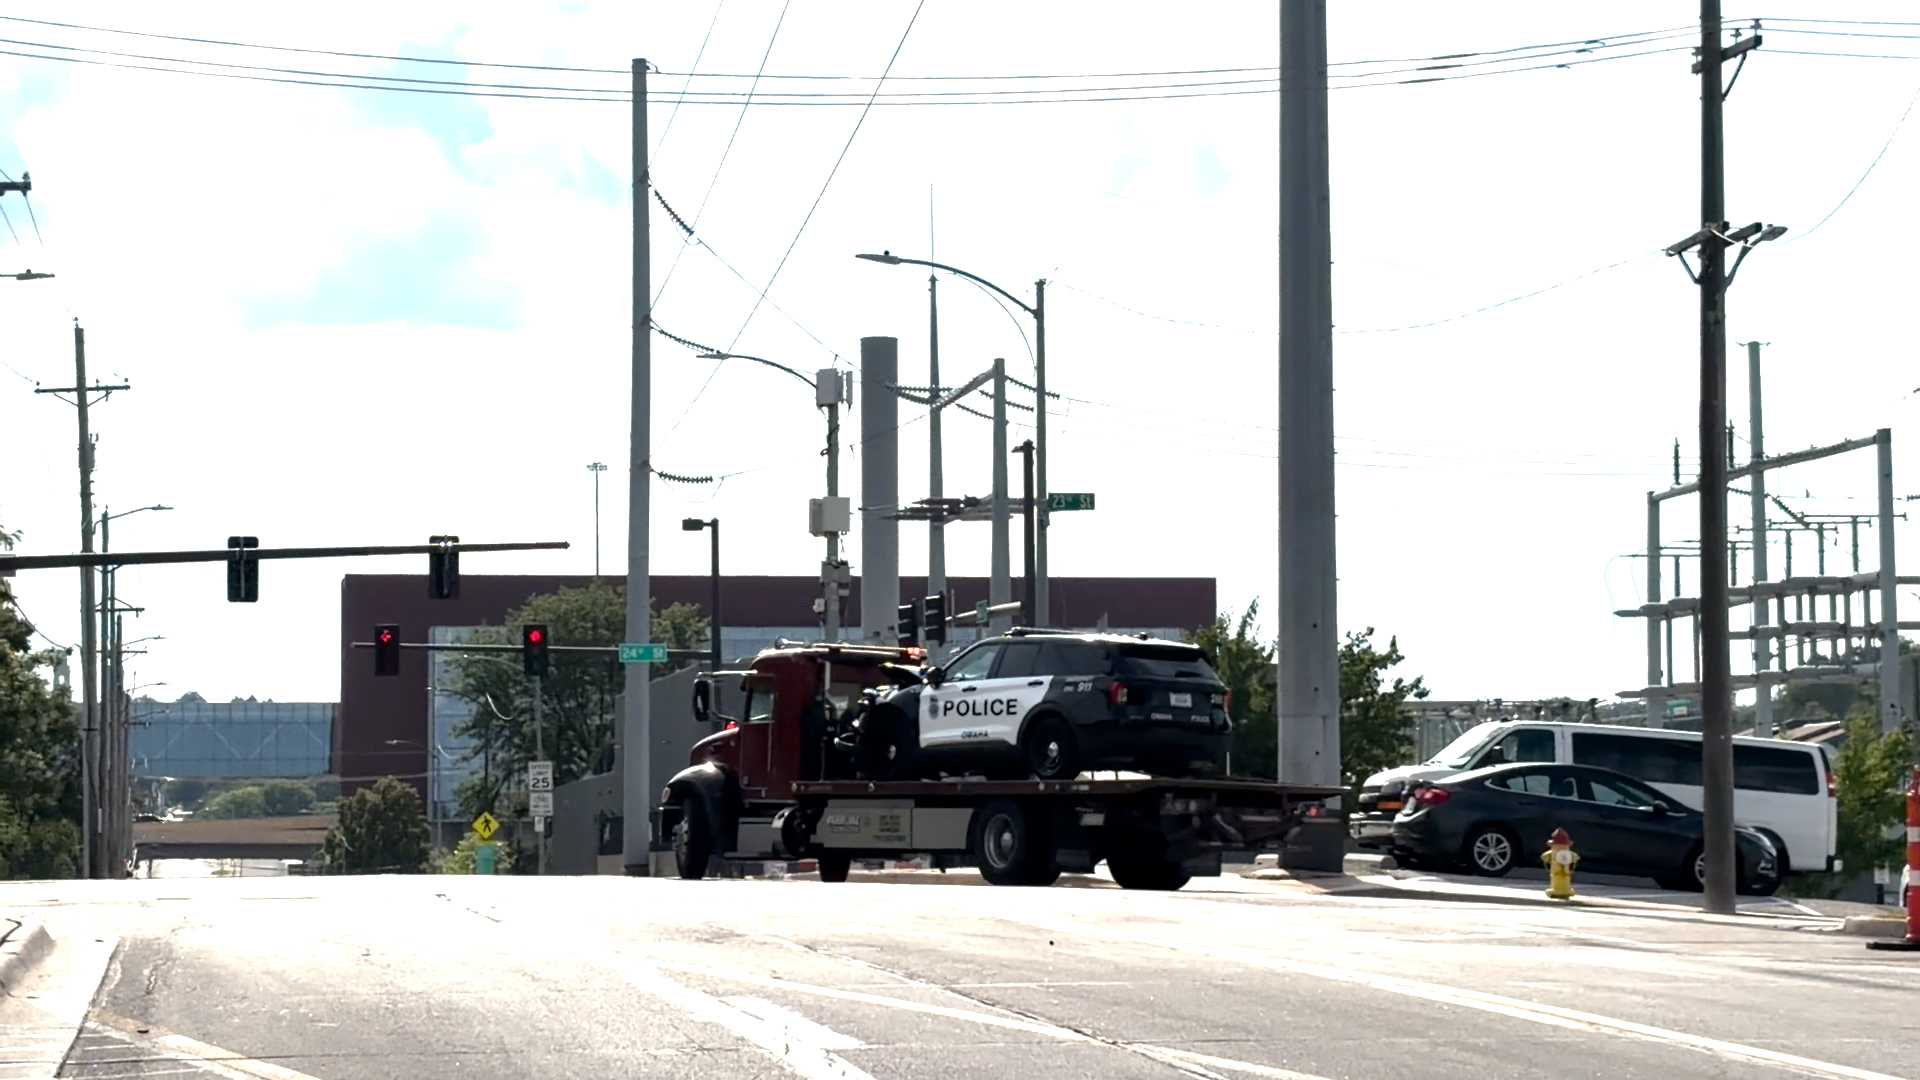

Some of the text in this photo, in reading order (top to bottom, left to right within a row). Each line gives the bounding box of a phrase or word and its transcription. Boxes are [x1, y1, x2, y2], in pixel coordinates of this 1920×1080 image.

[943, 698, 1018, 717] POLICE
[960, 729, 989, 740] OMAHA
[531, 777, 550, 789] 25
